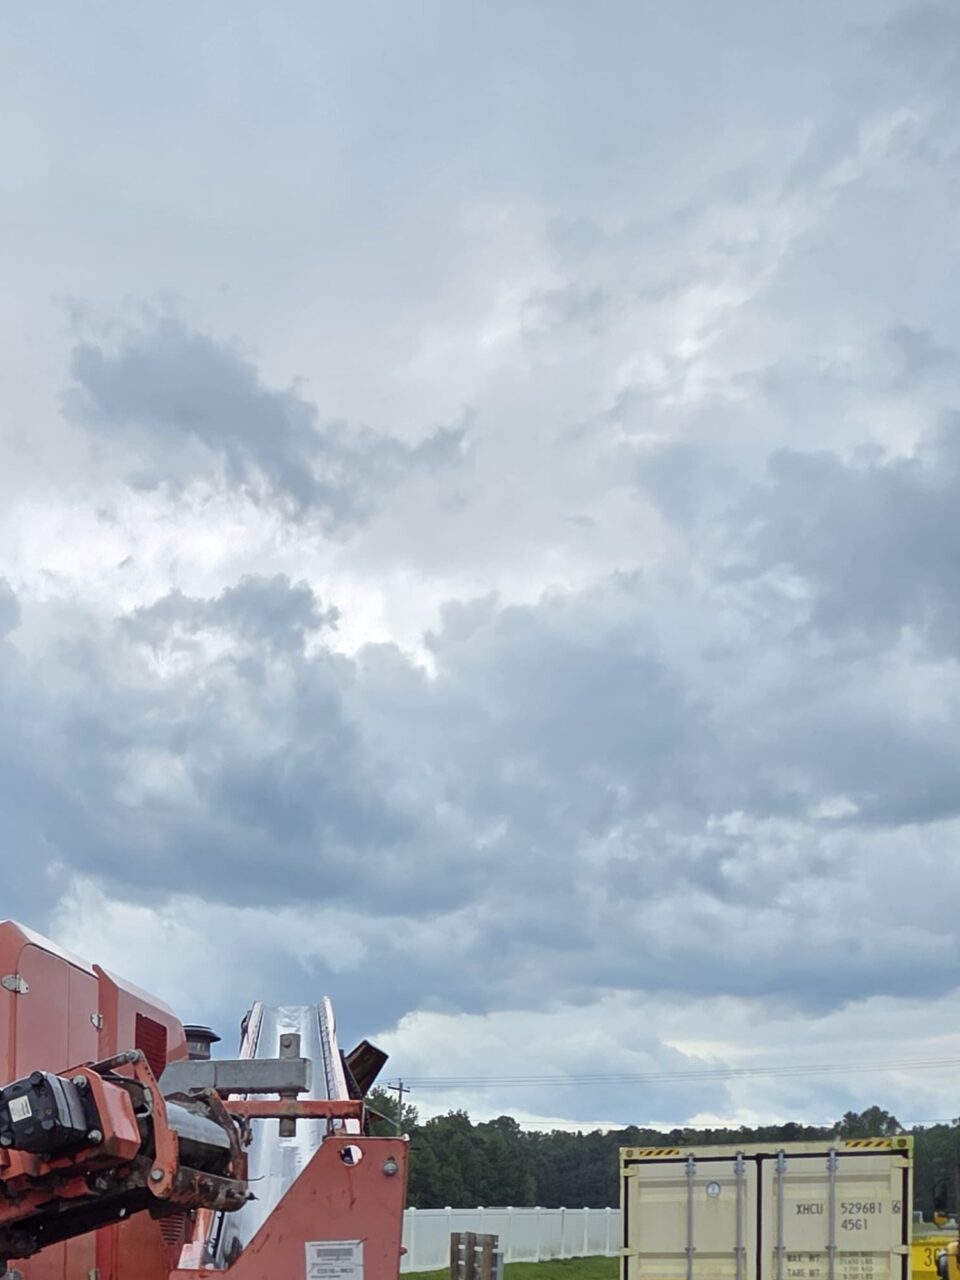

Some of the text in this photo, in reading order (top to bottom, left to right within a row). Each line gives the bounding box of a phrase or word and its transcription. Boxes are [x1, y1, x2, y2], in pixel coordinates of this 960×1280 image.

[796, 1202, 901, 1215] XHCU 529681 6
[841, 1218, 868, 1230] 45G1
